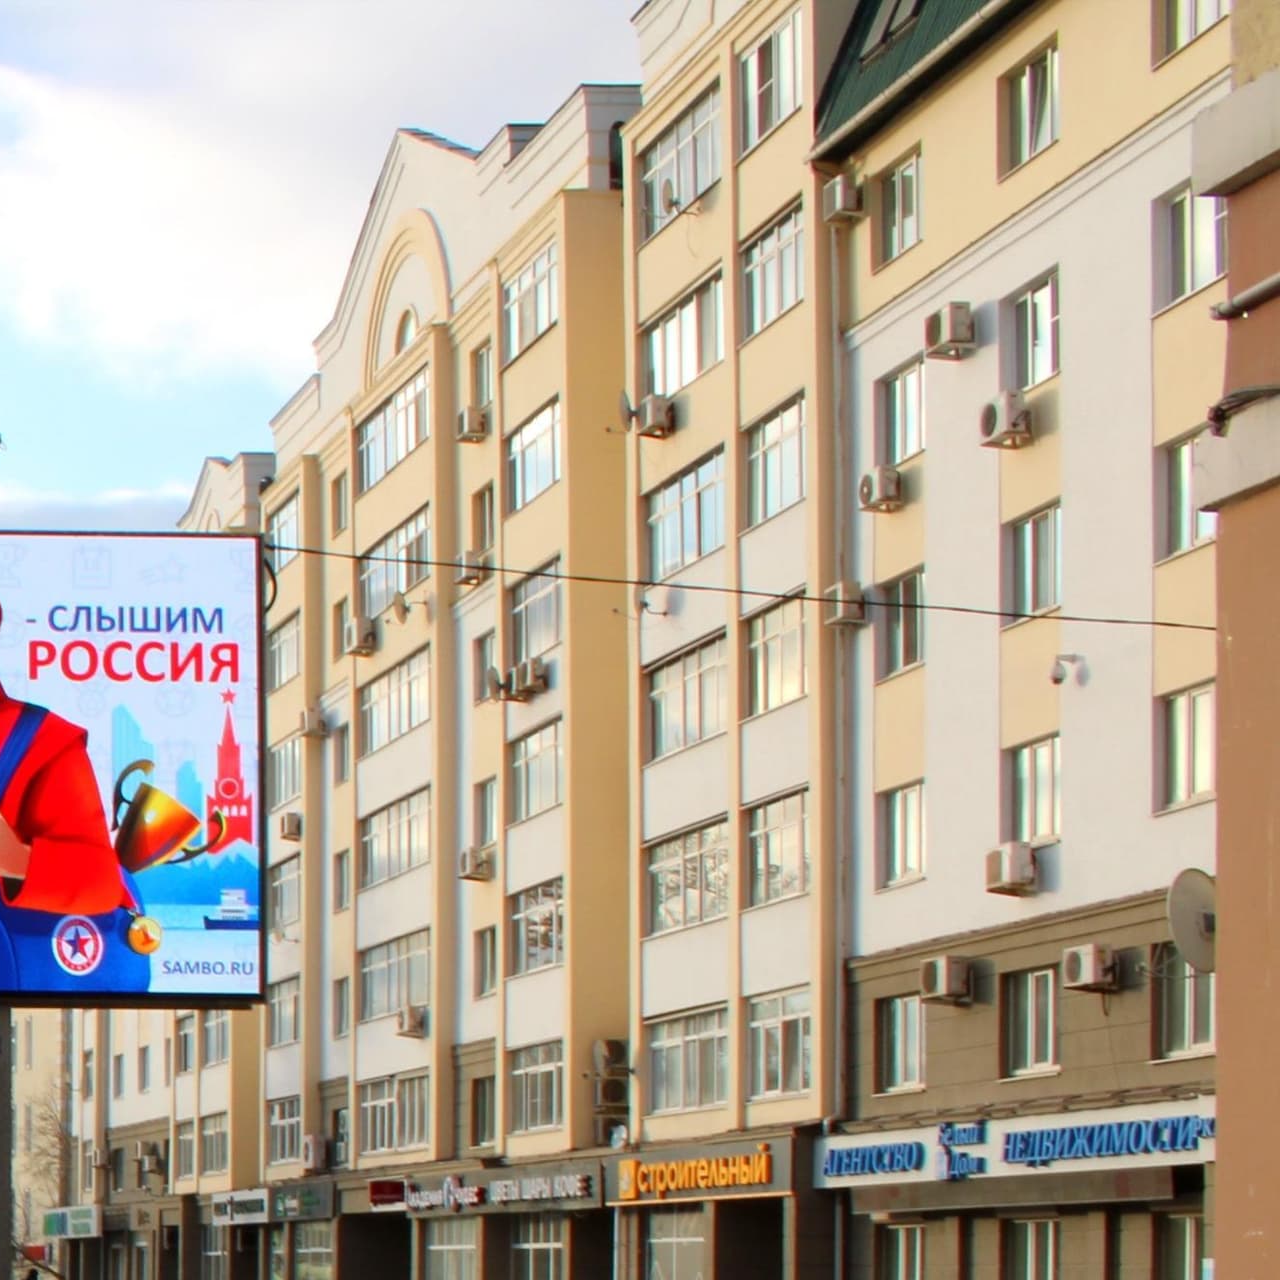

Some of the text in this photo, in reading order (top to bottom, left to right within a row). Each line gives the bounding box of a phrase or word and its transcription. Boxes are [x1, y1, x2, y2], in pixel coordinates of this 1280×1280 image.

[47, 605, 224, 633] СЛЫШИМ
[28, 640, 240, 683] РОССИЯ
[162, 960, 254, 976] SAMBO.RU
[824, 1140, 924, 1177] АГЕНТСТВО
[1004, 1114, 1199, 1167] НЕДВИЖИМОСТИ
[637, 1142, 772, 1199] строительный
